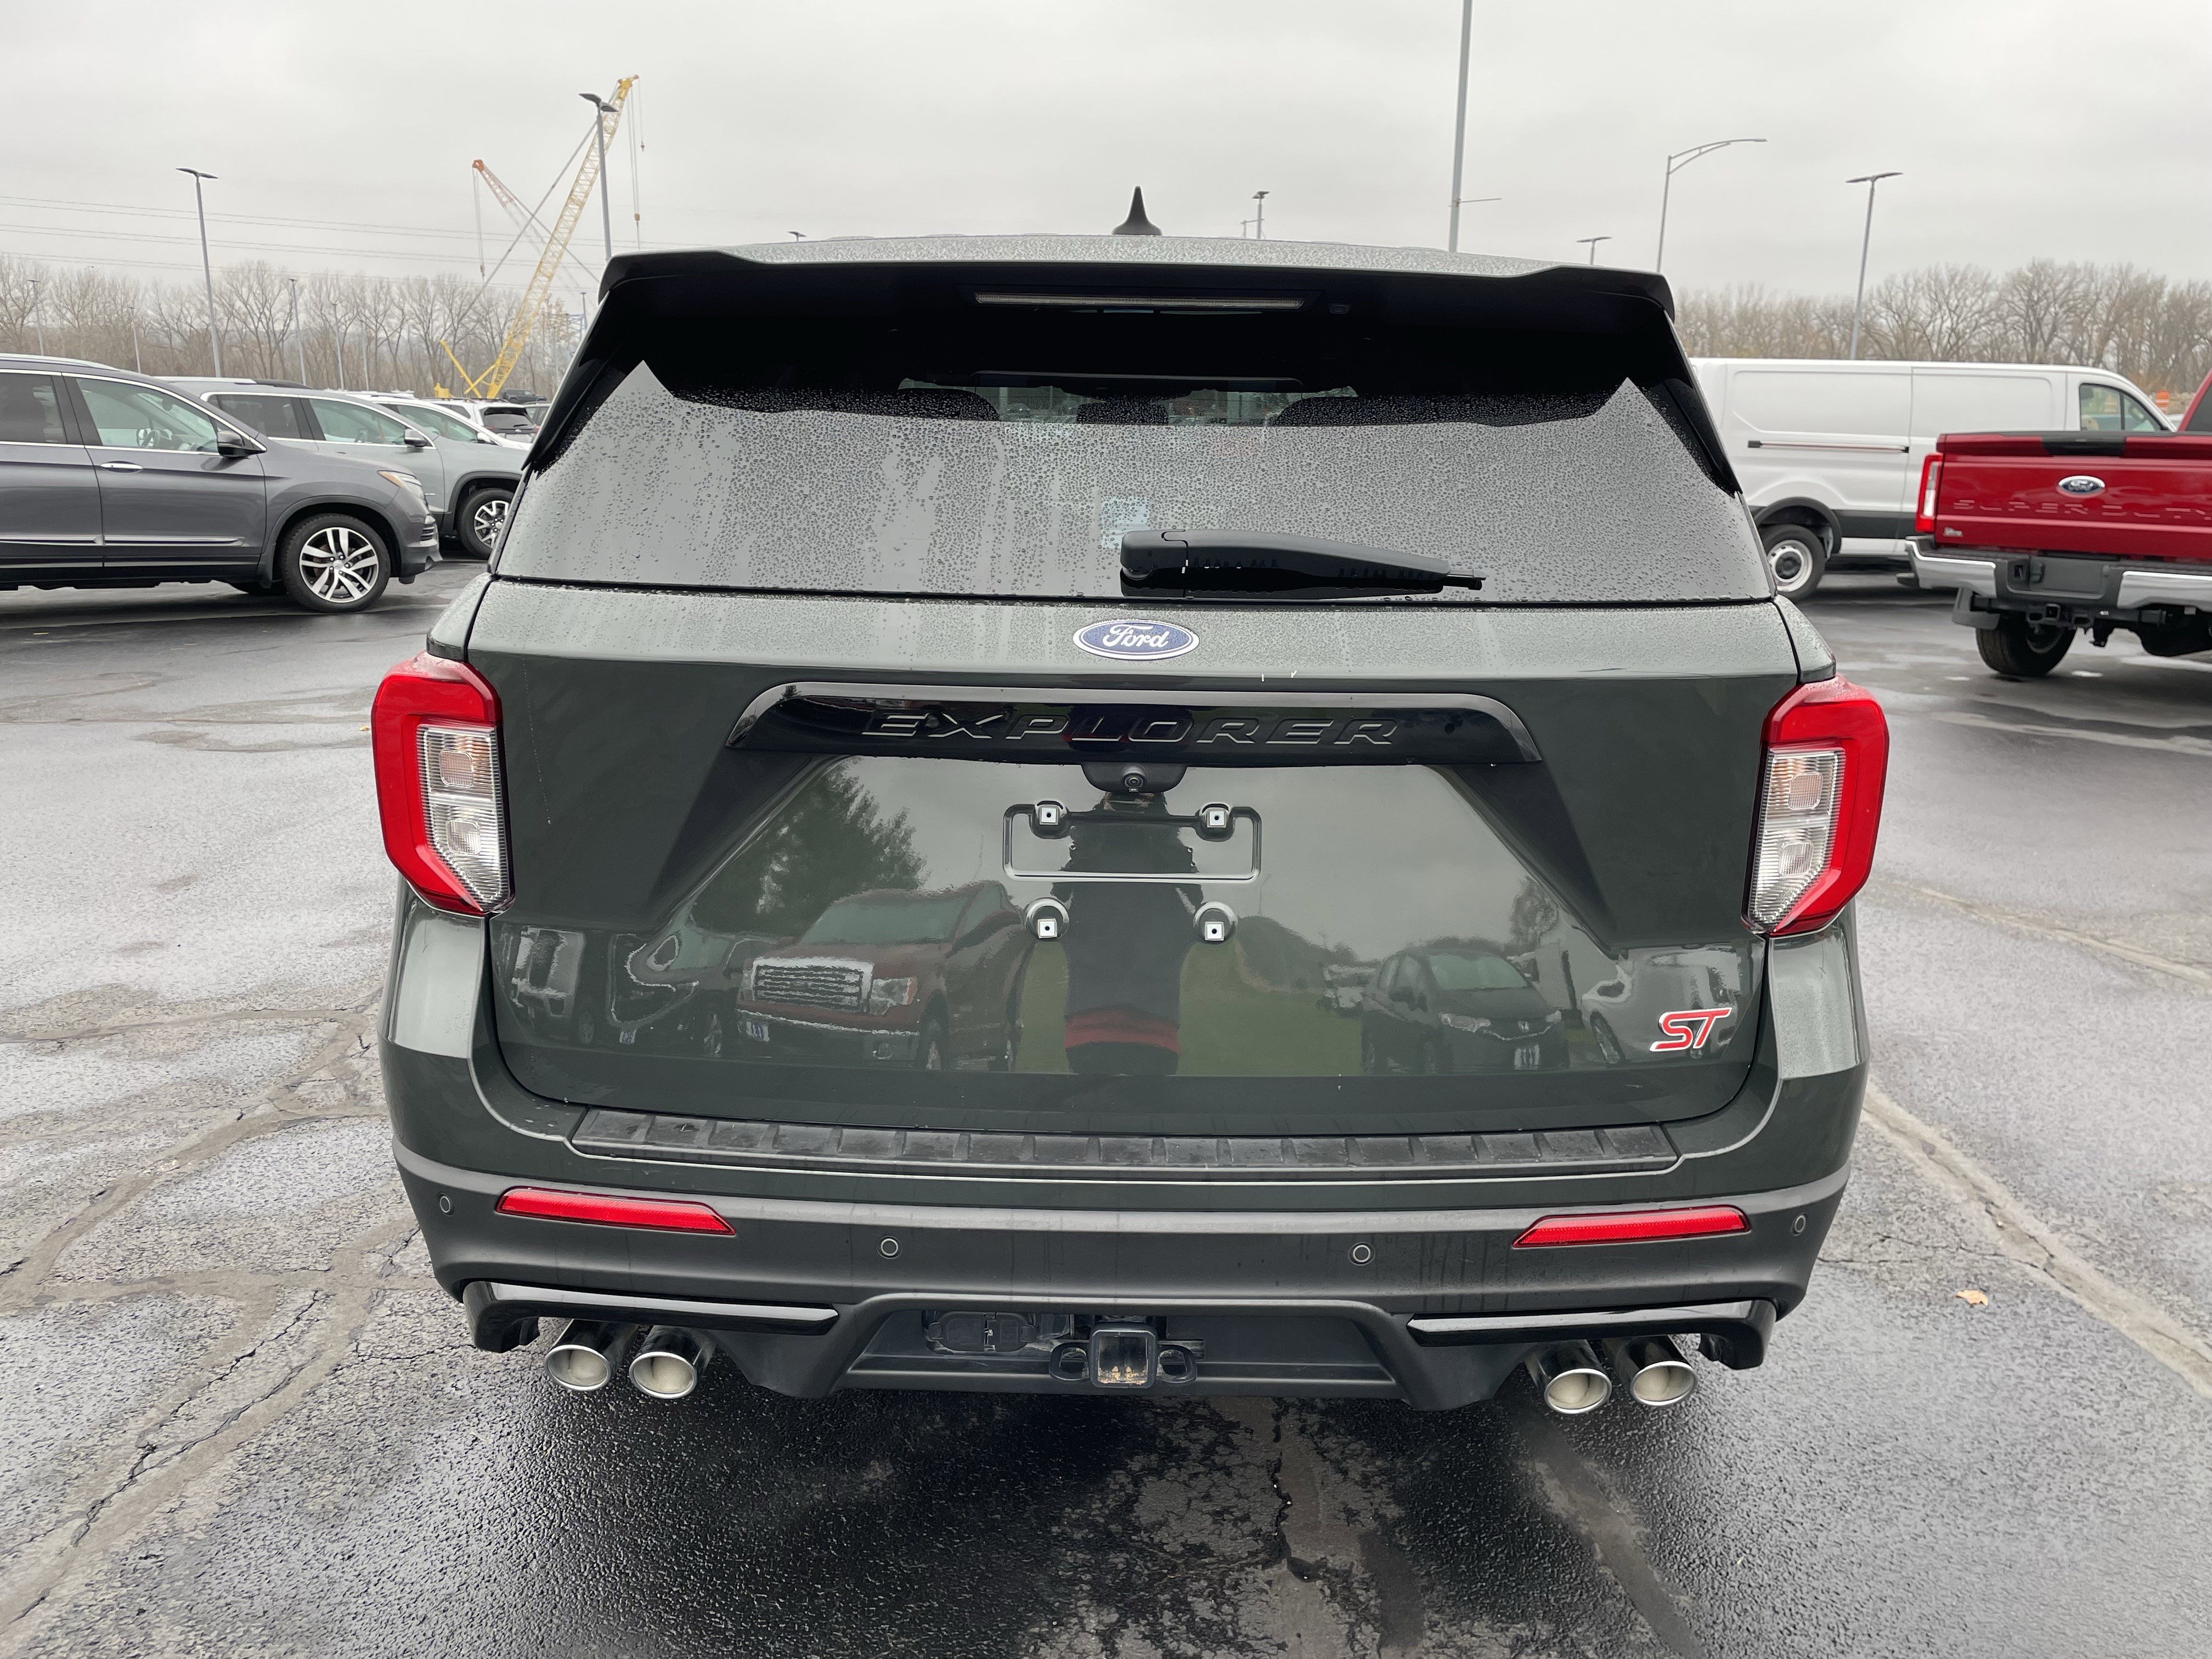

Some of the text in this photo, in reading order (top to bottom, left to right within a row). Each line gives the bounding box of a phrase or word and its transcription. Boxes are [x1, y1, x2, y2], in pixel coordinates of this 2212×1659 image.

[1953, 499, 2089, 515] SUPER
[1103, 624, 1170, 647] Ford
[861, 712, 1398, 745] EXPLORER
[1649, 1007, 1733, 1052] ST
